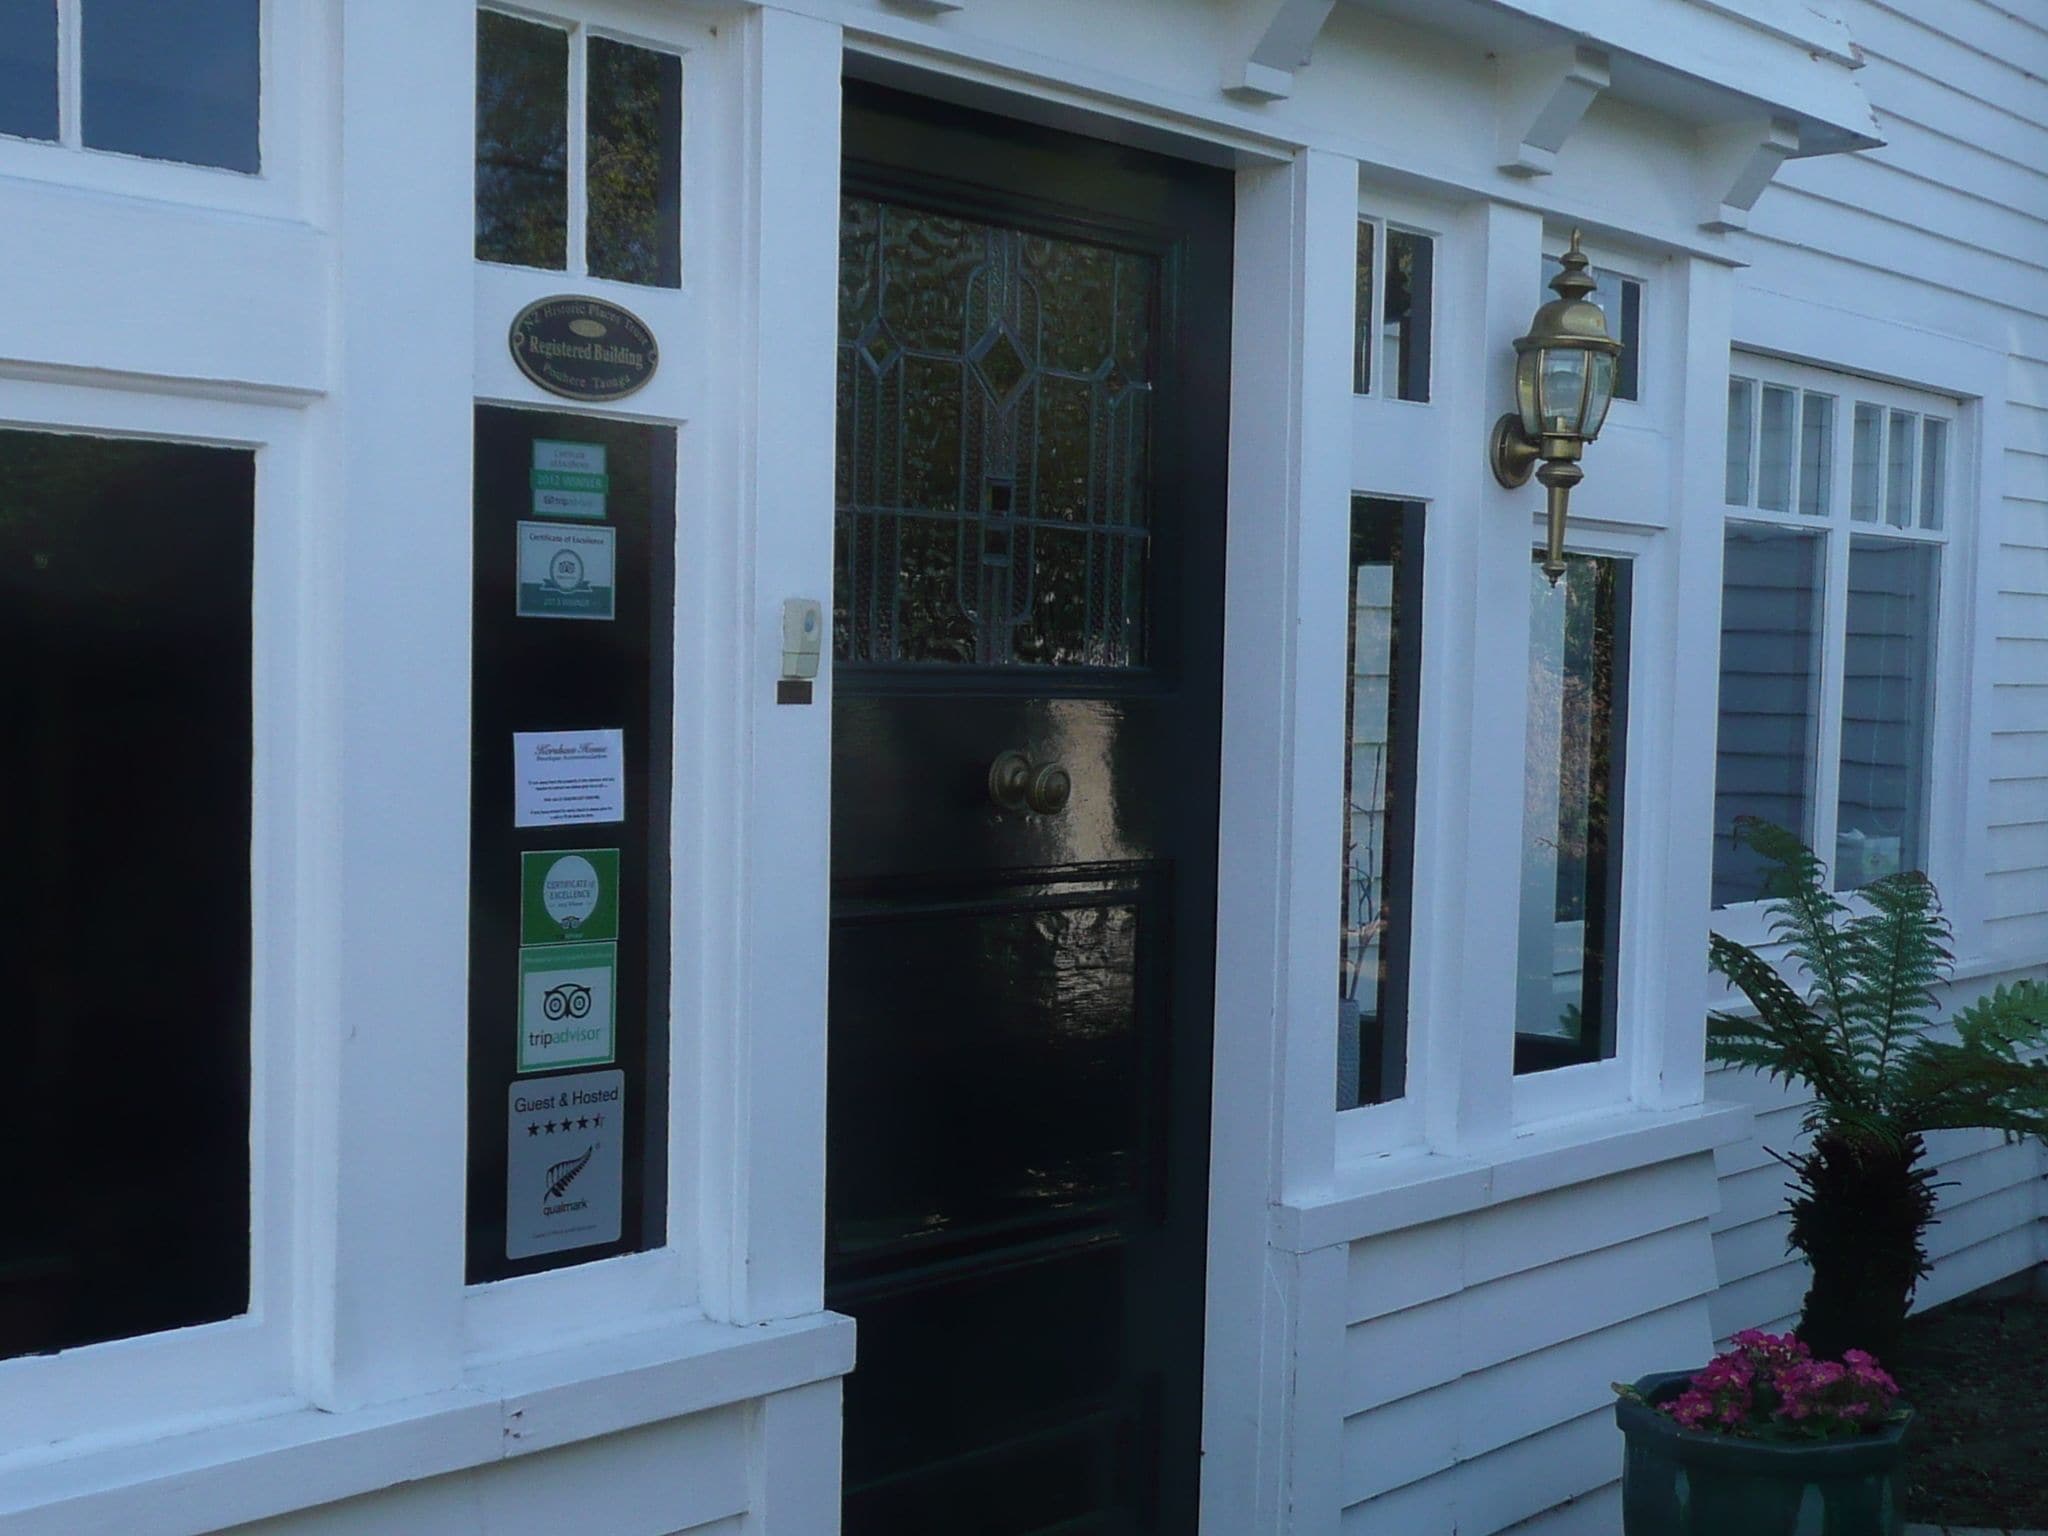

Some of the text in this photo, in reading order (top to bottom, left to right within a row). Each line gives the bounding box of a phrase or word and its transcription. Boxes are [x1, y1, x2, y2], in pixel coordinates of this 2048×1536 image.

[543, 303, 586, 319] Historic
[529, 335, 644, 370] Registered Building
[529, 532, 562, 544] Certificate
[546, 879, 588, 890] CERTIFICATE
[549, 889, 591, 901] EXCELLENCE
[528, 1026, 601, 1049] tripadvisor
[514, 1086, 619, 1113] Guest & Hosted
[543, 1199, 588, 1217] qualmark
